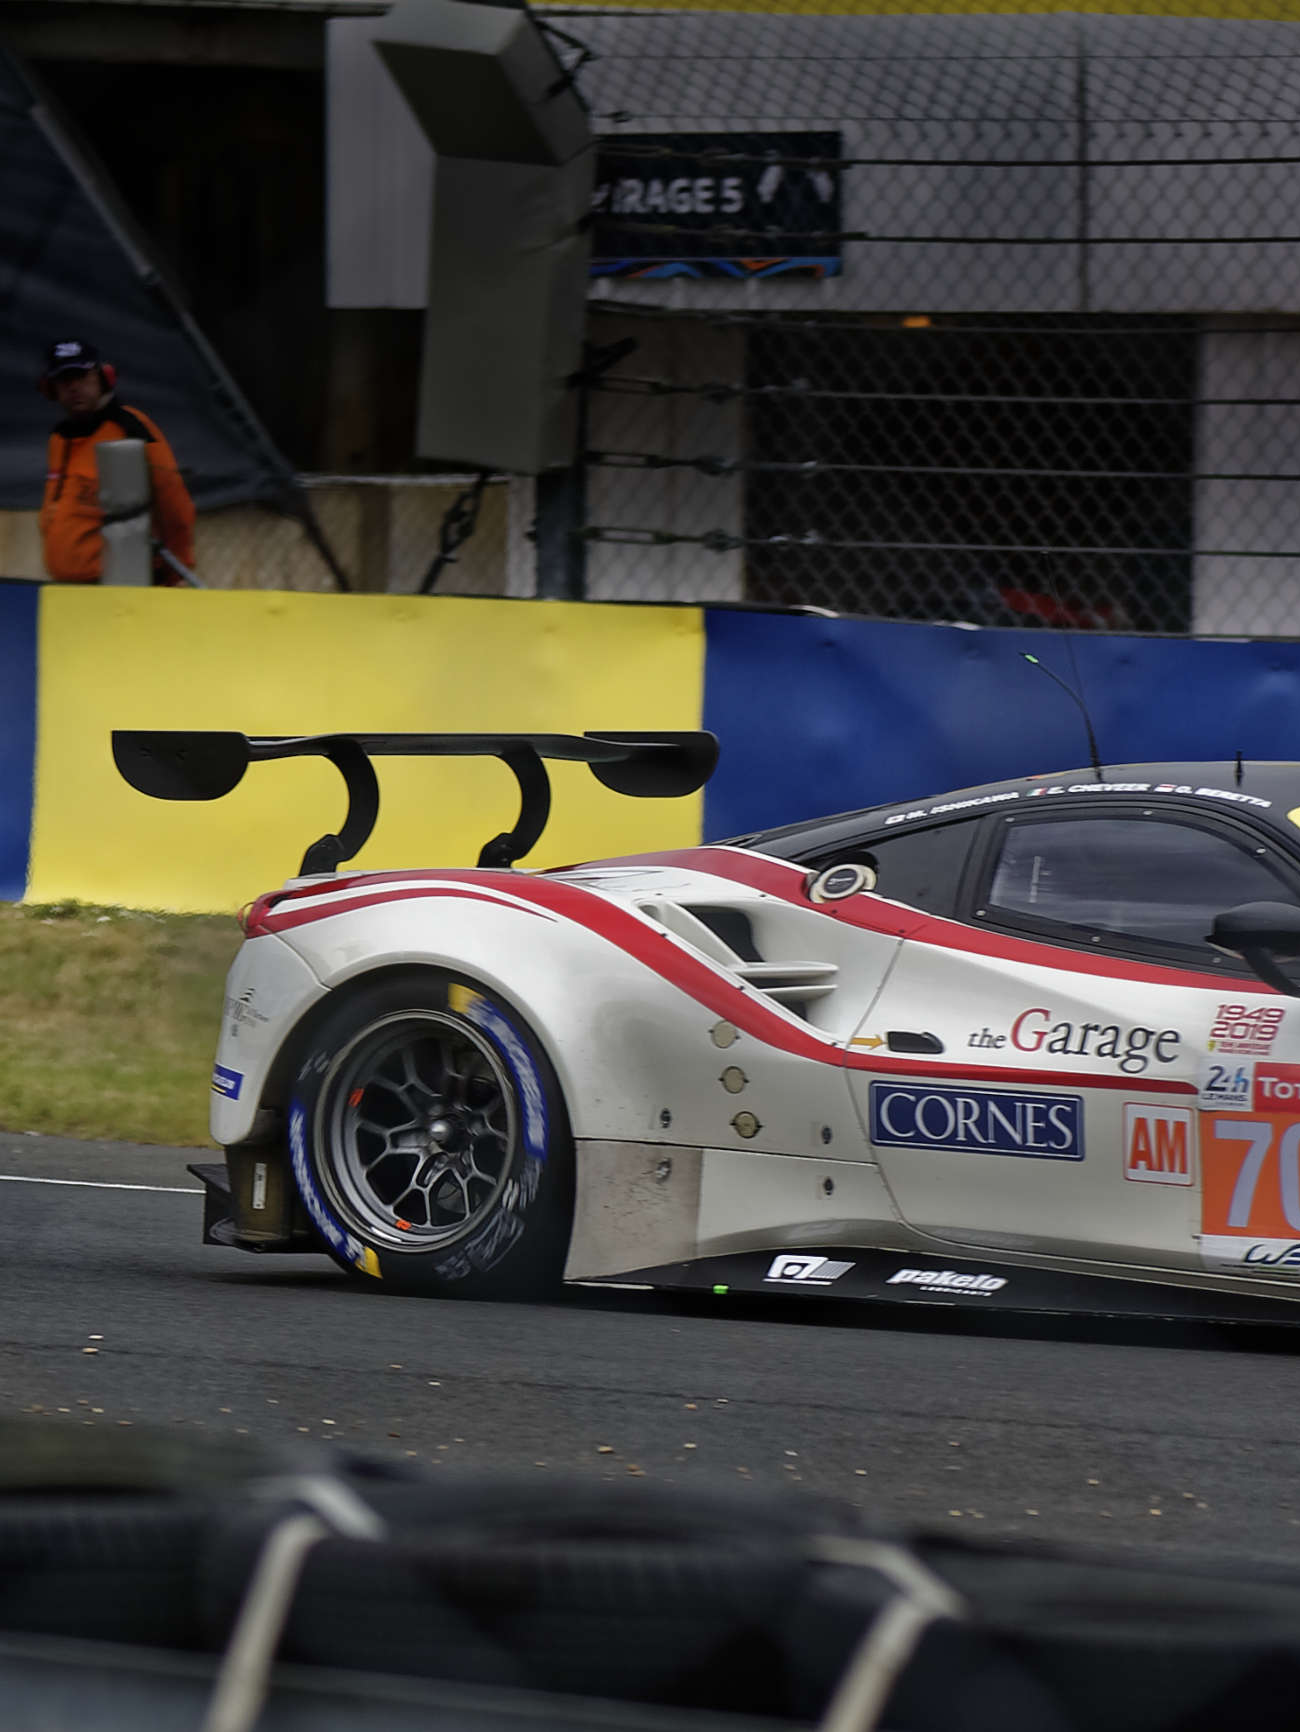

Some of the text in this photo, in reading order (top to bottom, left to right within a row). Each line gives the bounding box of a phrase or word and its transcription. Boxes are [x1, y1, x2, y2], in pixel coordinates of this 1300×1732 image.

[720, 177, 744, 214] 5
[1209, 1020, 1280, 1041] 2019
[1217, 1004, 1285, 1024] 1949
[967, 1007, 1182, 1074] the Garage
[880, 1091, 1074, 1150] CORNES
[1129, 1116, 1188, 1175] AM
[885, 1268, 1009, 1291] pakelo
